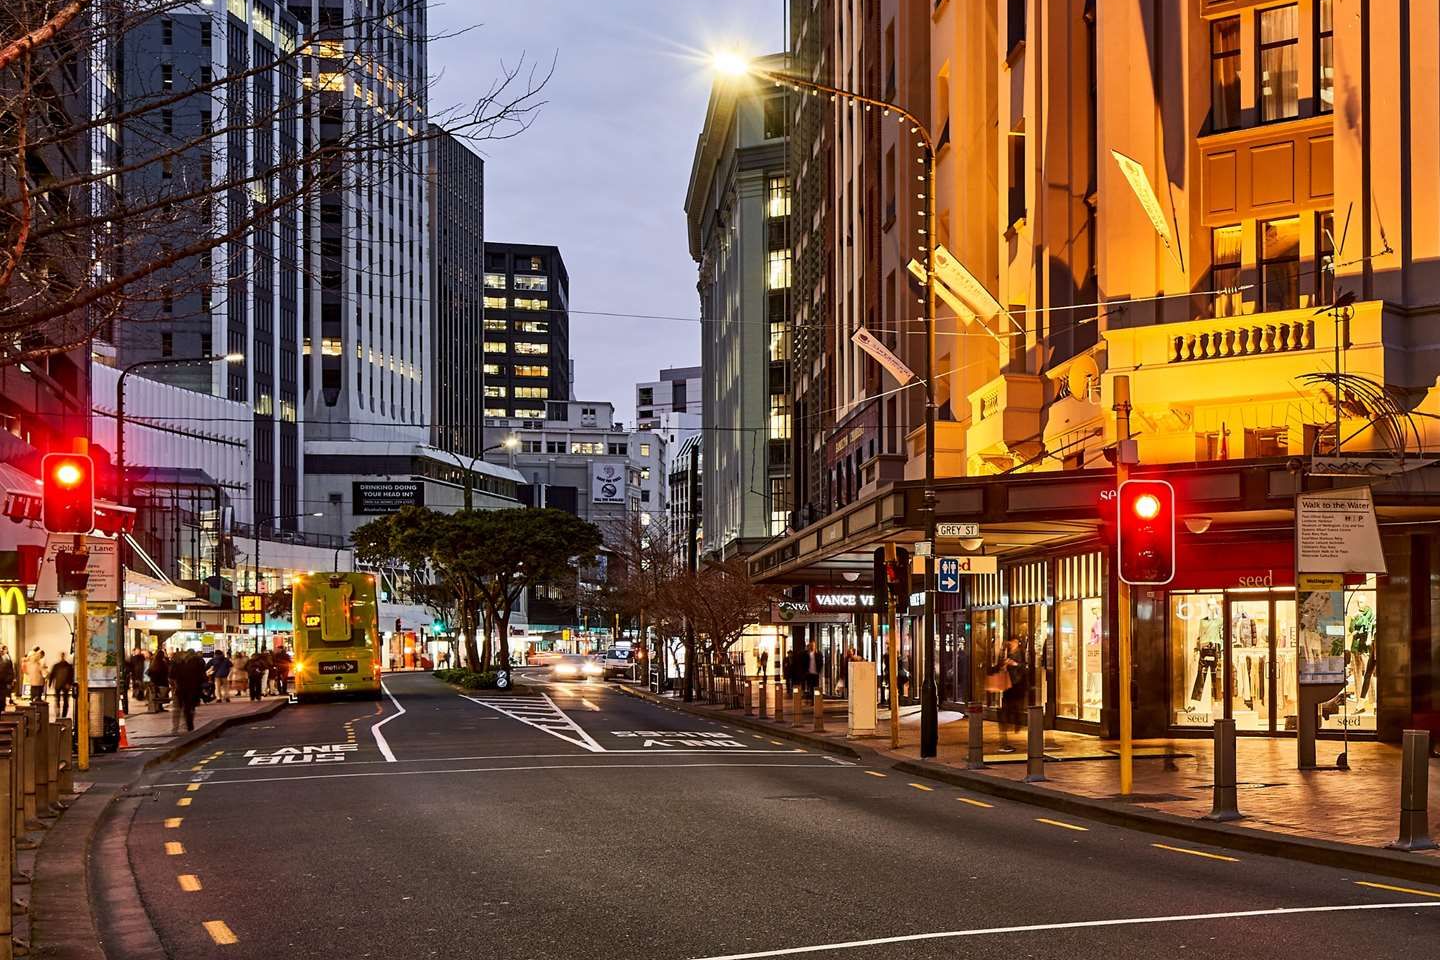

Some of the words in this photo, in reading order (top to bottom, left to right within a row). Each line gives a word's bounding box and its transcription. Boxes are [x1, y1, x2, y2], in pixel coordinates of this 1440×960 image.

[1302, 501, 1321, 509] Walk
[1322, 501, 1331, 509] to
[1332, 501, 1346, 509] the
[1347, 501, 1370, 509] Water
[940, 525, 961, 535] GREY
[965, 525, 975, 535] ST
[94, 544, 113, 552] Lane
[1238, 569, 1273, 587] seed
[816, 594, 857, 606] VANCE
[1187, 712, 1209, 723] seed
[1337, 716, 1361, 727] seed
[243, 743, 358, 758] LANE
[247, 752, 345, 766] BUS
